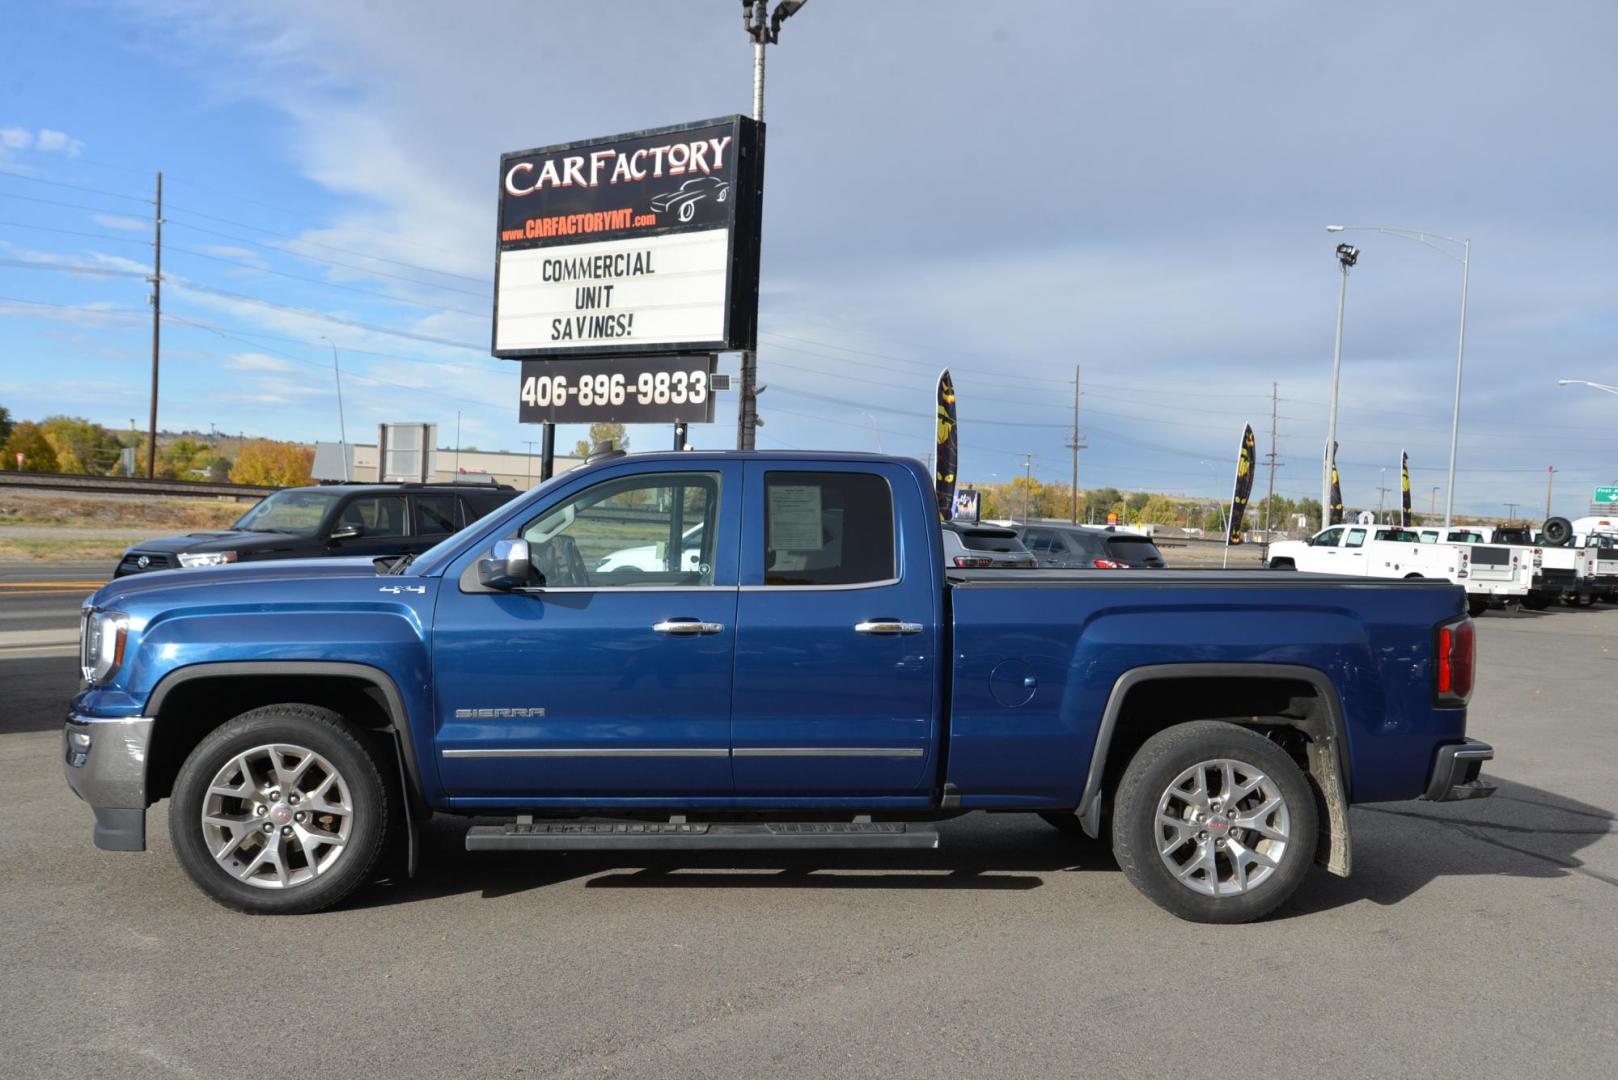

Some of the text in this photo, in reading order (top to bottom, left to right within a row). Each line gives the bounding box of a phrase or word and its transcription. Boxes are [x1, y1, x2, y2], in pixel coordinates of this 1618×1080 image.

[502, 208, 656, 241] www.CARFACTORYMT.com
[542, 251, 655, 282] COMMERCIAL
[575, 285, 614, 310] UNIT
[551, 313, 634, 341] SAVINGS!
[521, 370, 707, 407] 406-896-9833
[455, 707, 546, 719] SIERRA
